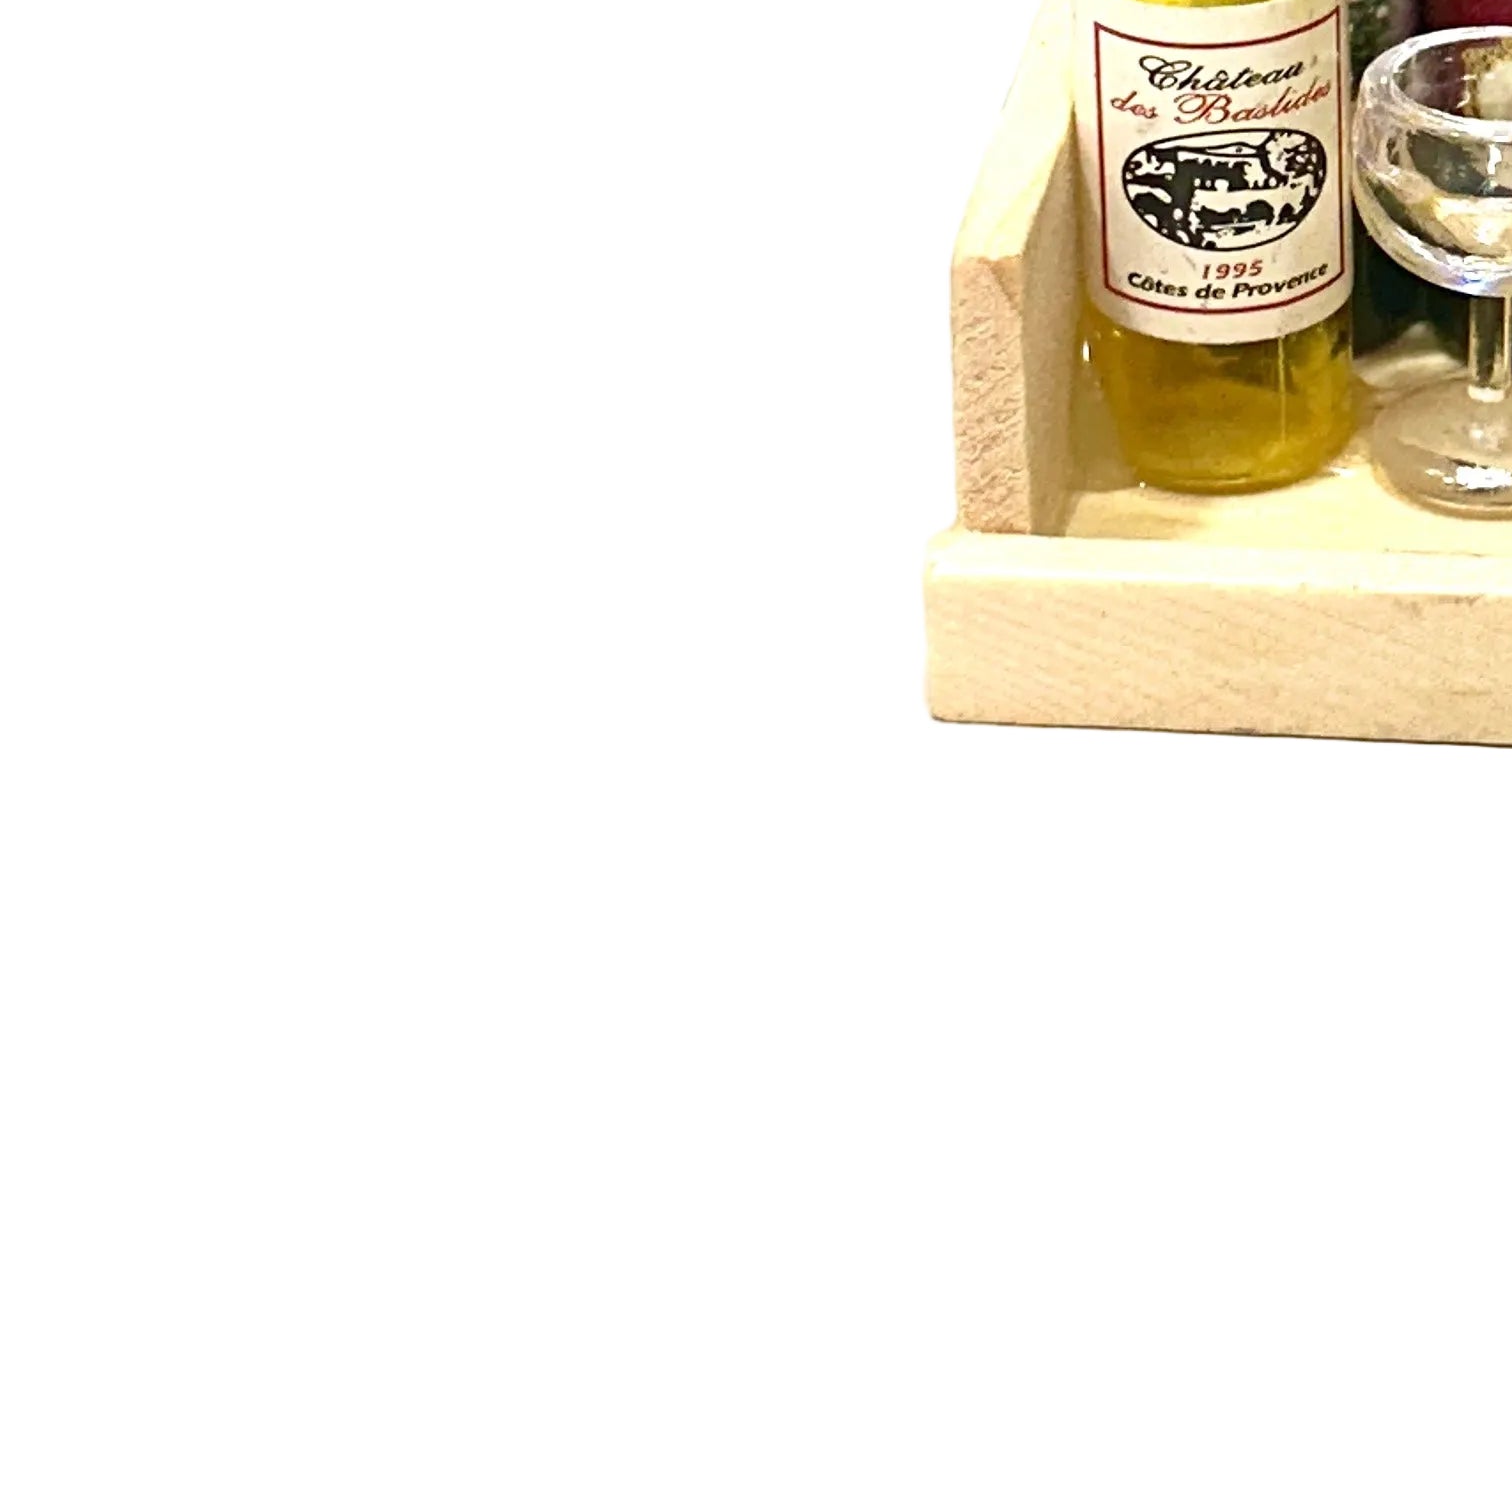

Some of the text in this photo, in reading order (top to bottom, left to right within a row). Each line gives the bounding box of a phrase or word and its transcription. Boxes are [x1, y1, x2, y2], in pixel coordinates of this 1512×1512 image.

[1138, 54, 1306, 91] Château
[1195, 283, 1226, 300] de
[1232, 263, 1329, 298] Provence
[1202, 258, 1263, 281] 1995
